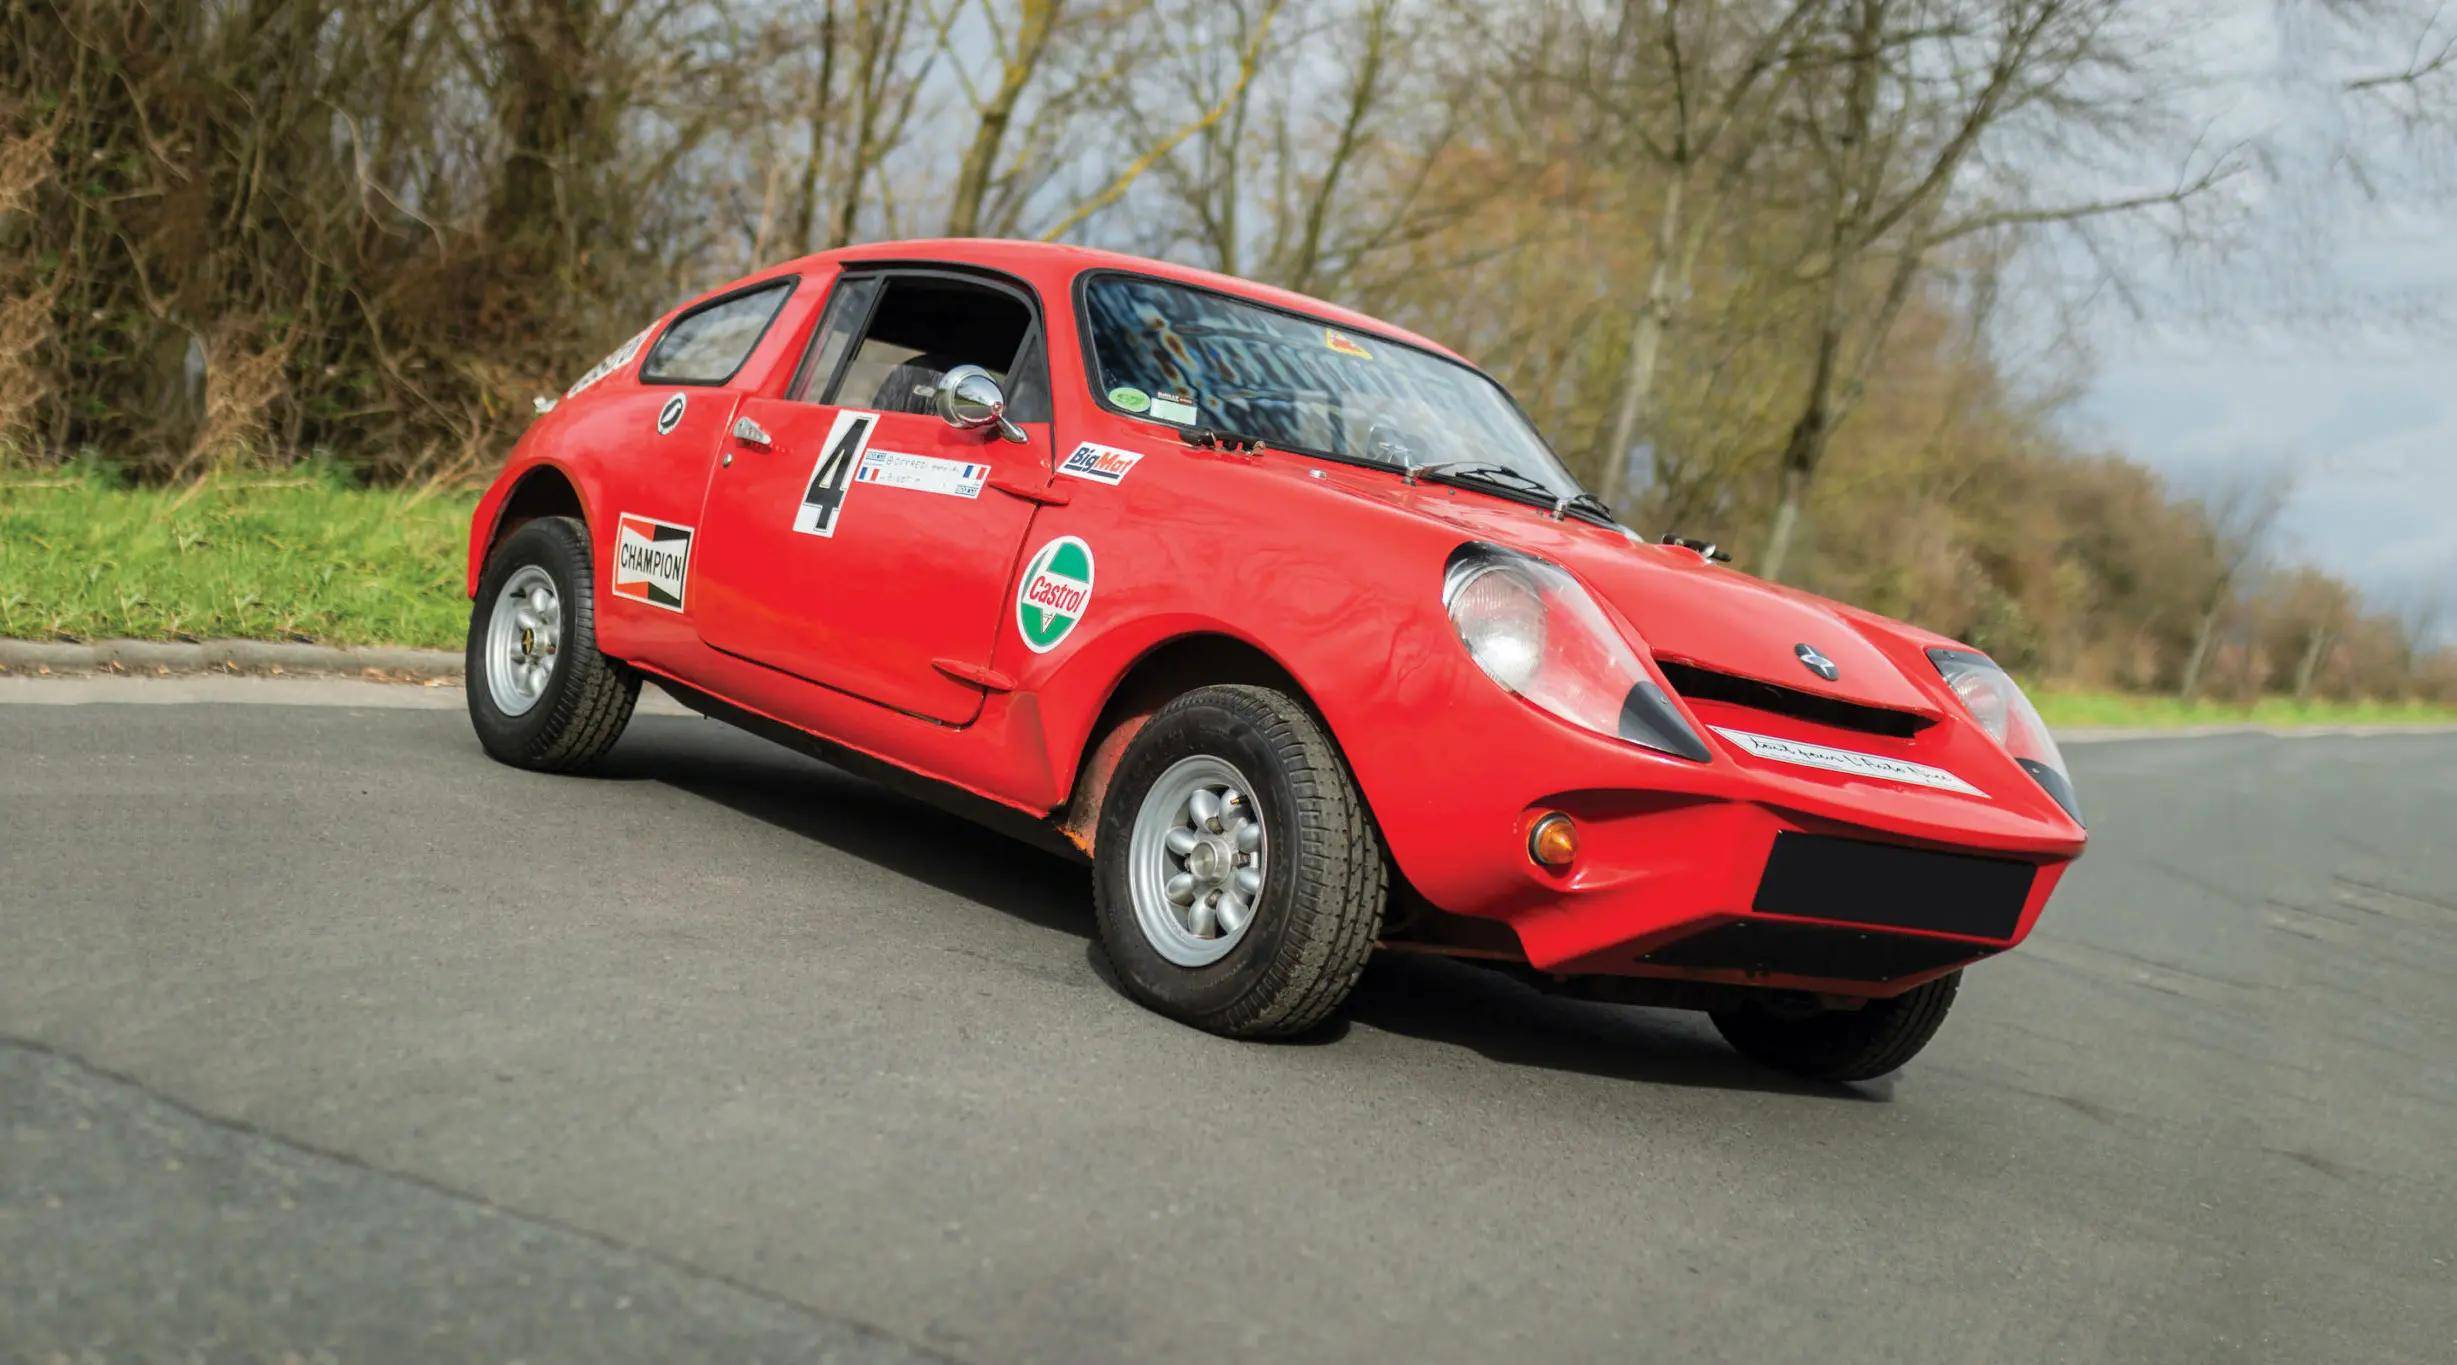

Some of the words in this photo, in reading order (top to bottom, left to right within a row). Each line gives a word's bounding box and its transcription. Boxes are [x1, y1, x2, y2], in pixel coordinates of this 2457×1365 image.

[804, 417, 872, 531] 4
[1069, 447, 1133, 474] BigMat
[621, 543, 682, 581] CHAMPION
[1030, 576, 1087, 613] Castrol
